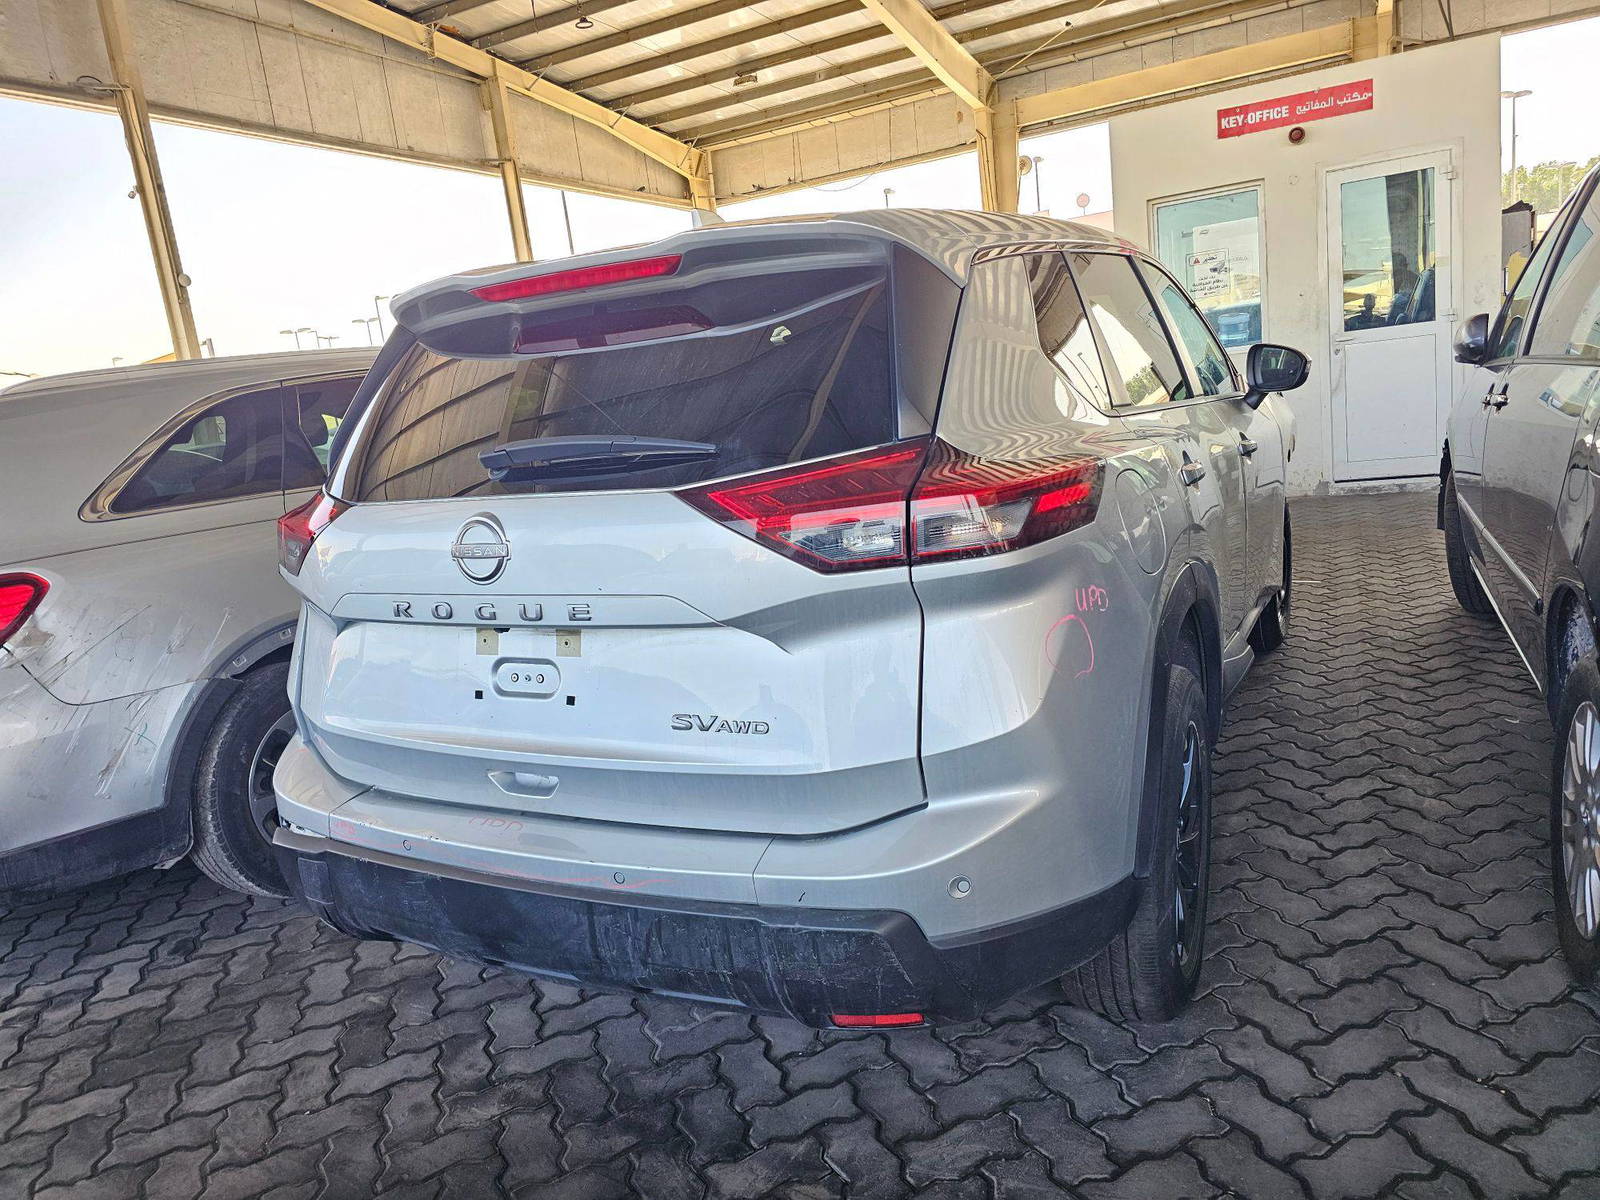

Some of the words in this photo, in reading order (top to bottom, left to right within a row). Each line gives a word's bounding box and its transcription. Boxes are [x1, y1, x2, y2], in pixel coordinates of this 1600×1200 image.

[1296, 96, 1334, 115] المفاتيح
[1336, 91, 1372, 107] مكتب
[1221, 114, 1247, 129] KEY
[1247, 105, 1289, 124] OFFICE
[452, 544, 506, 557] NISSAN
[1075, 584, 1109, 612] UPD
[392, 601, 593, 622] ROGUE
